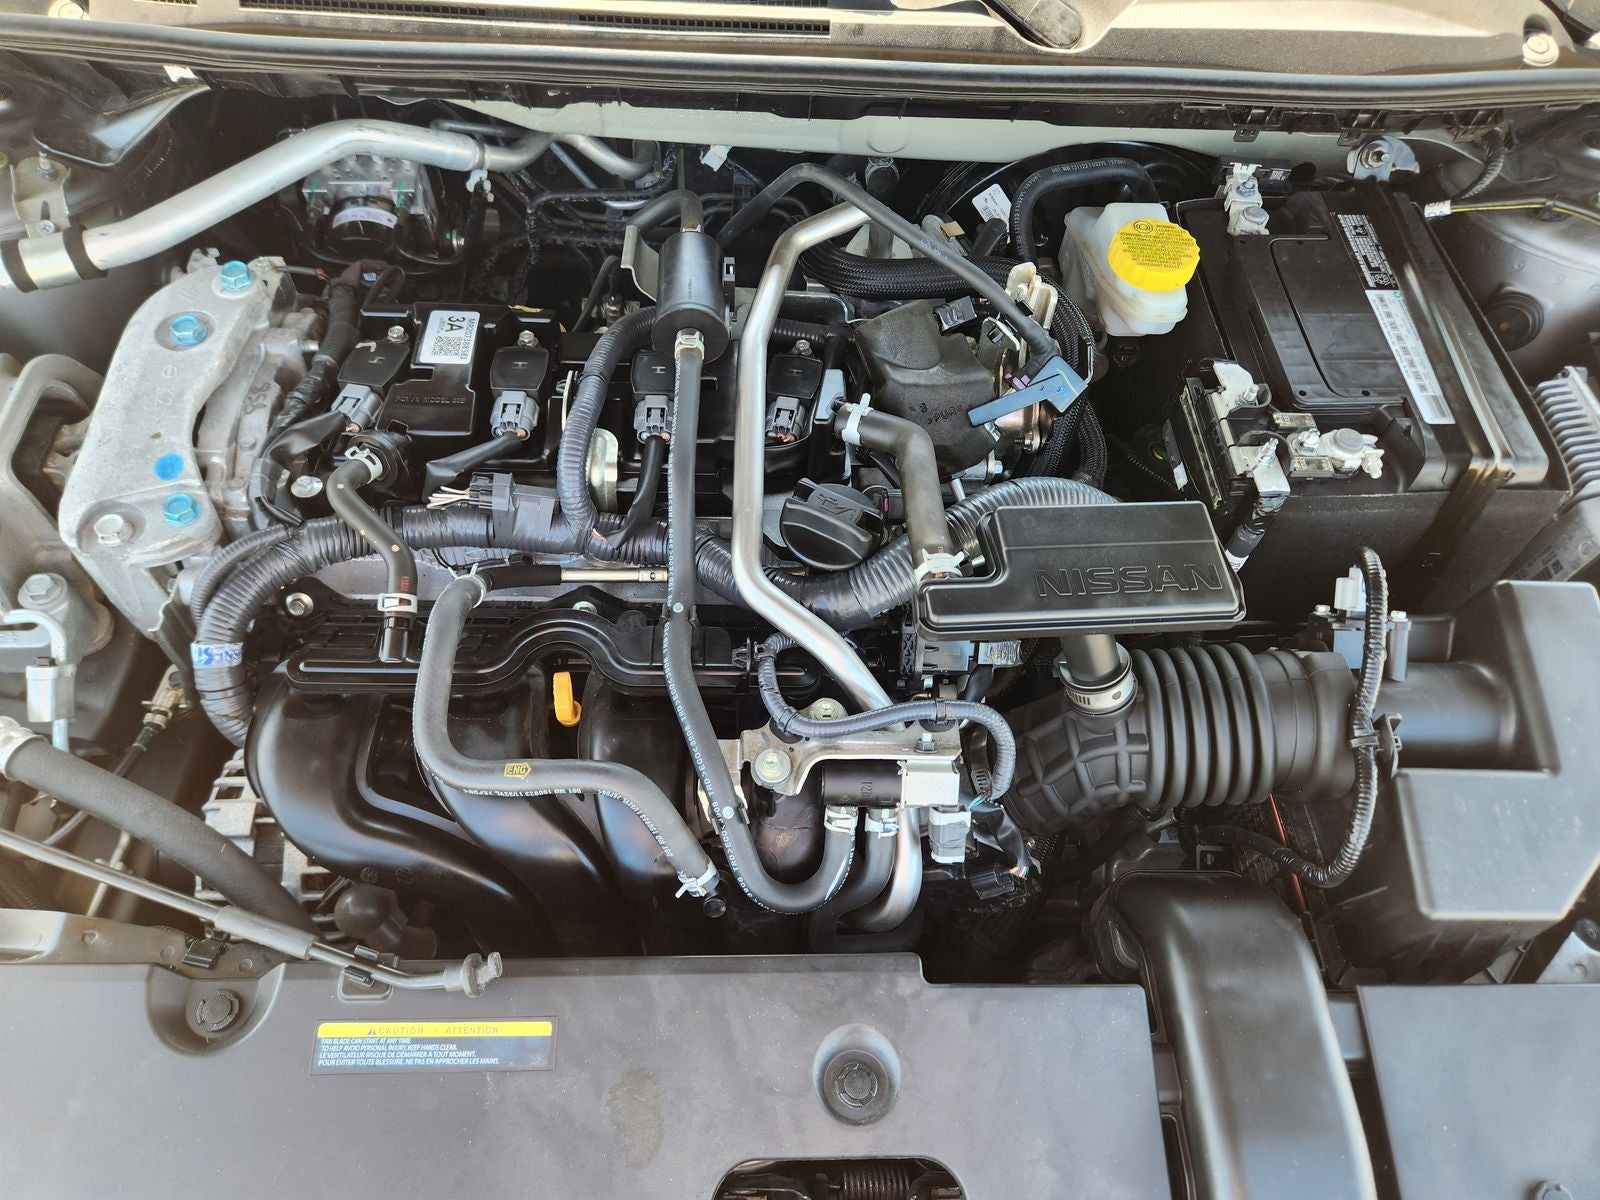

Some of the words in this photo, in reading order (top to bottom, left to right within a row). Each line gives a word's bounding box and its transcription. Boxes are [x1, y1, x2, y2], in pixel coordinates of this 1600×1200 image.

[445, 315, 466, 332] 3A
[1033, 563, 1223, 597] NISSAN
[507, 765, 527, 776] ENG
[379, 1027, 424, 1035] CAUTION
[445, 1026, 499, 1034] ATTENTION
